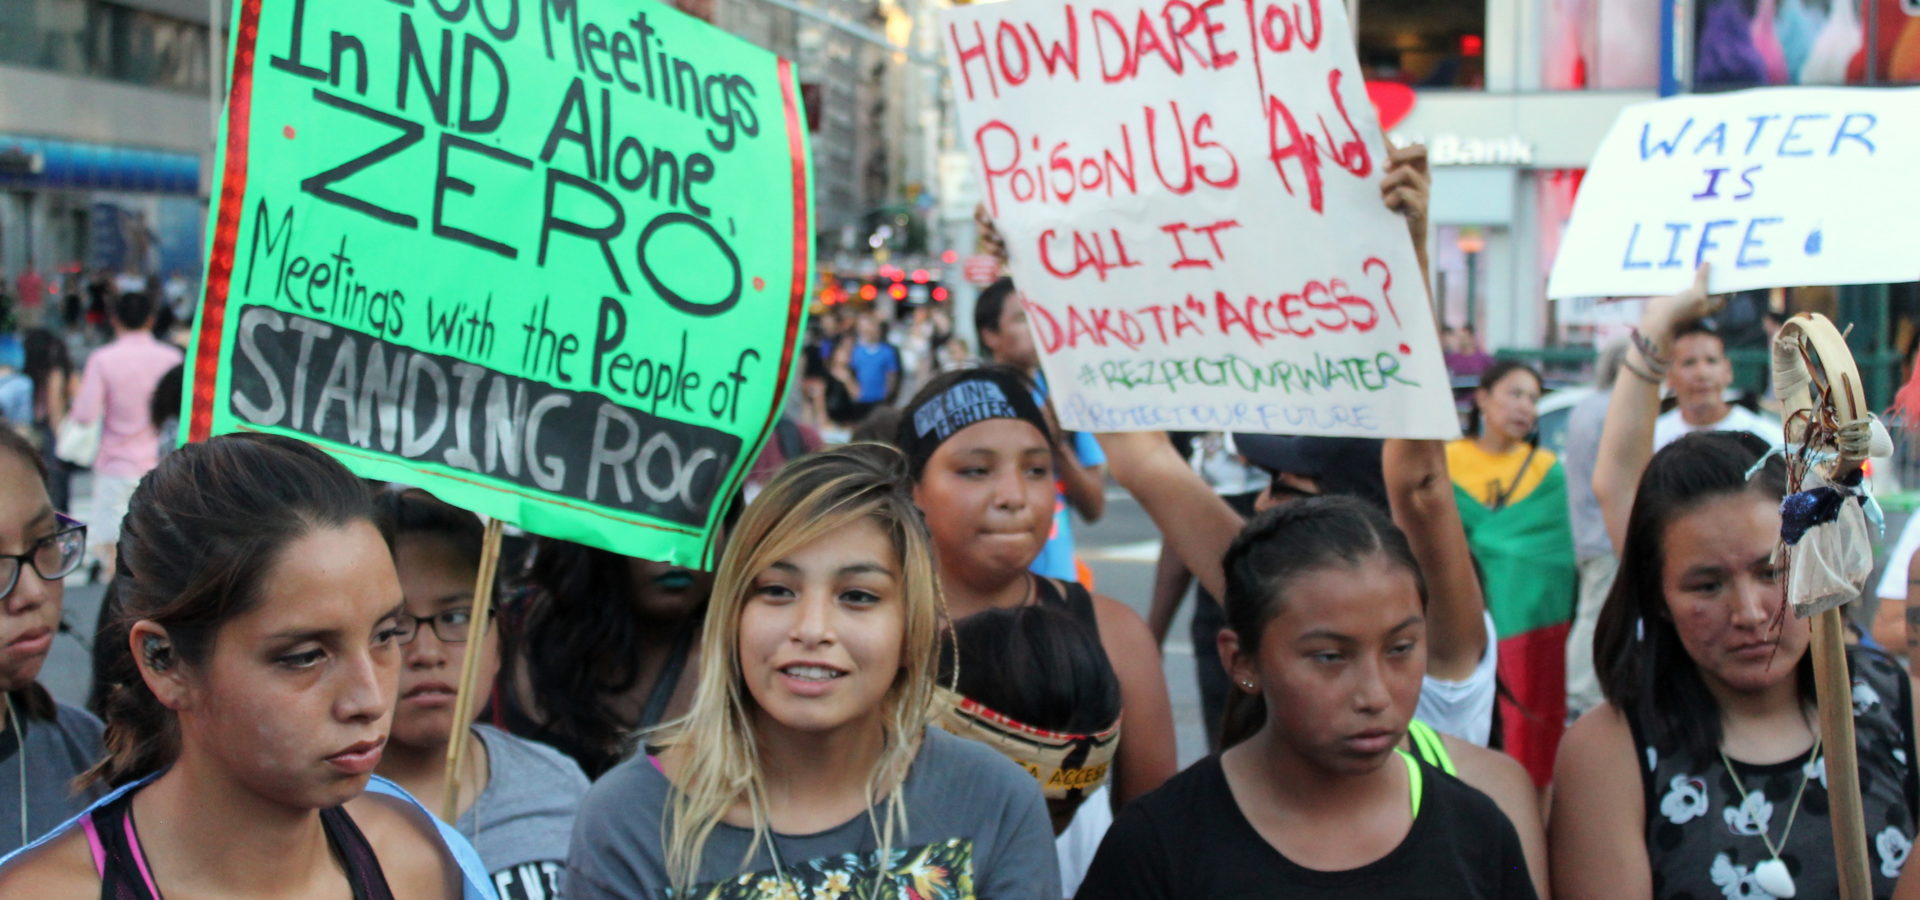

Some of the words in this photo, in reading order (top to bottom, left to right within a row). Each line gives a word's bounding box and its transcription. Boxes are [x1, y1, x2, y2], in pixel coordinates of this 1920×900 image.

[269, 0, 368, 96] In
[541, 0, 759, 152] Meetings
[950, 4, 1080, 100] HOW
[1091, 0, 1239, 83] DARE
[1143, 100, 1239, 195] US
[1434, 135, 1533, 165] Bank
[1639, 112, 1878, 161] WATER
[1692, 165, 1763, 201] IS
[300, 87, 742, 317] ZERO
[1621, 216, 1784, 269] LIFE
[1038, 228, 1141, 281] CALL
[1160, 219, 1243, 270] IT
[245, 196, 406, 340] Meetings
[523, 295, 579, 384] the
[591, 295, 701, 416] People
[709, 347, 761, 424] of
[231, 308, 572, 492] STANDING
[586, 402, 728, 513] ROC
